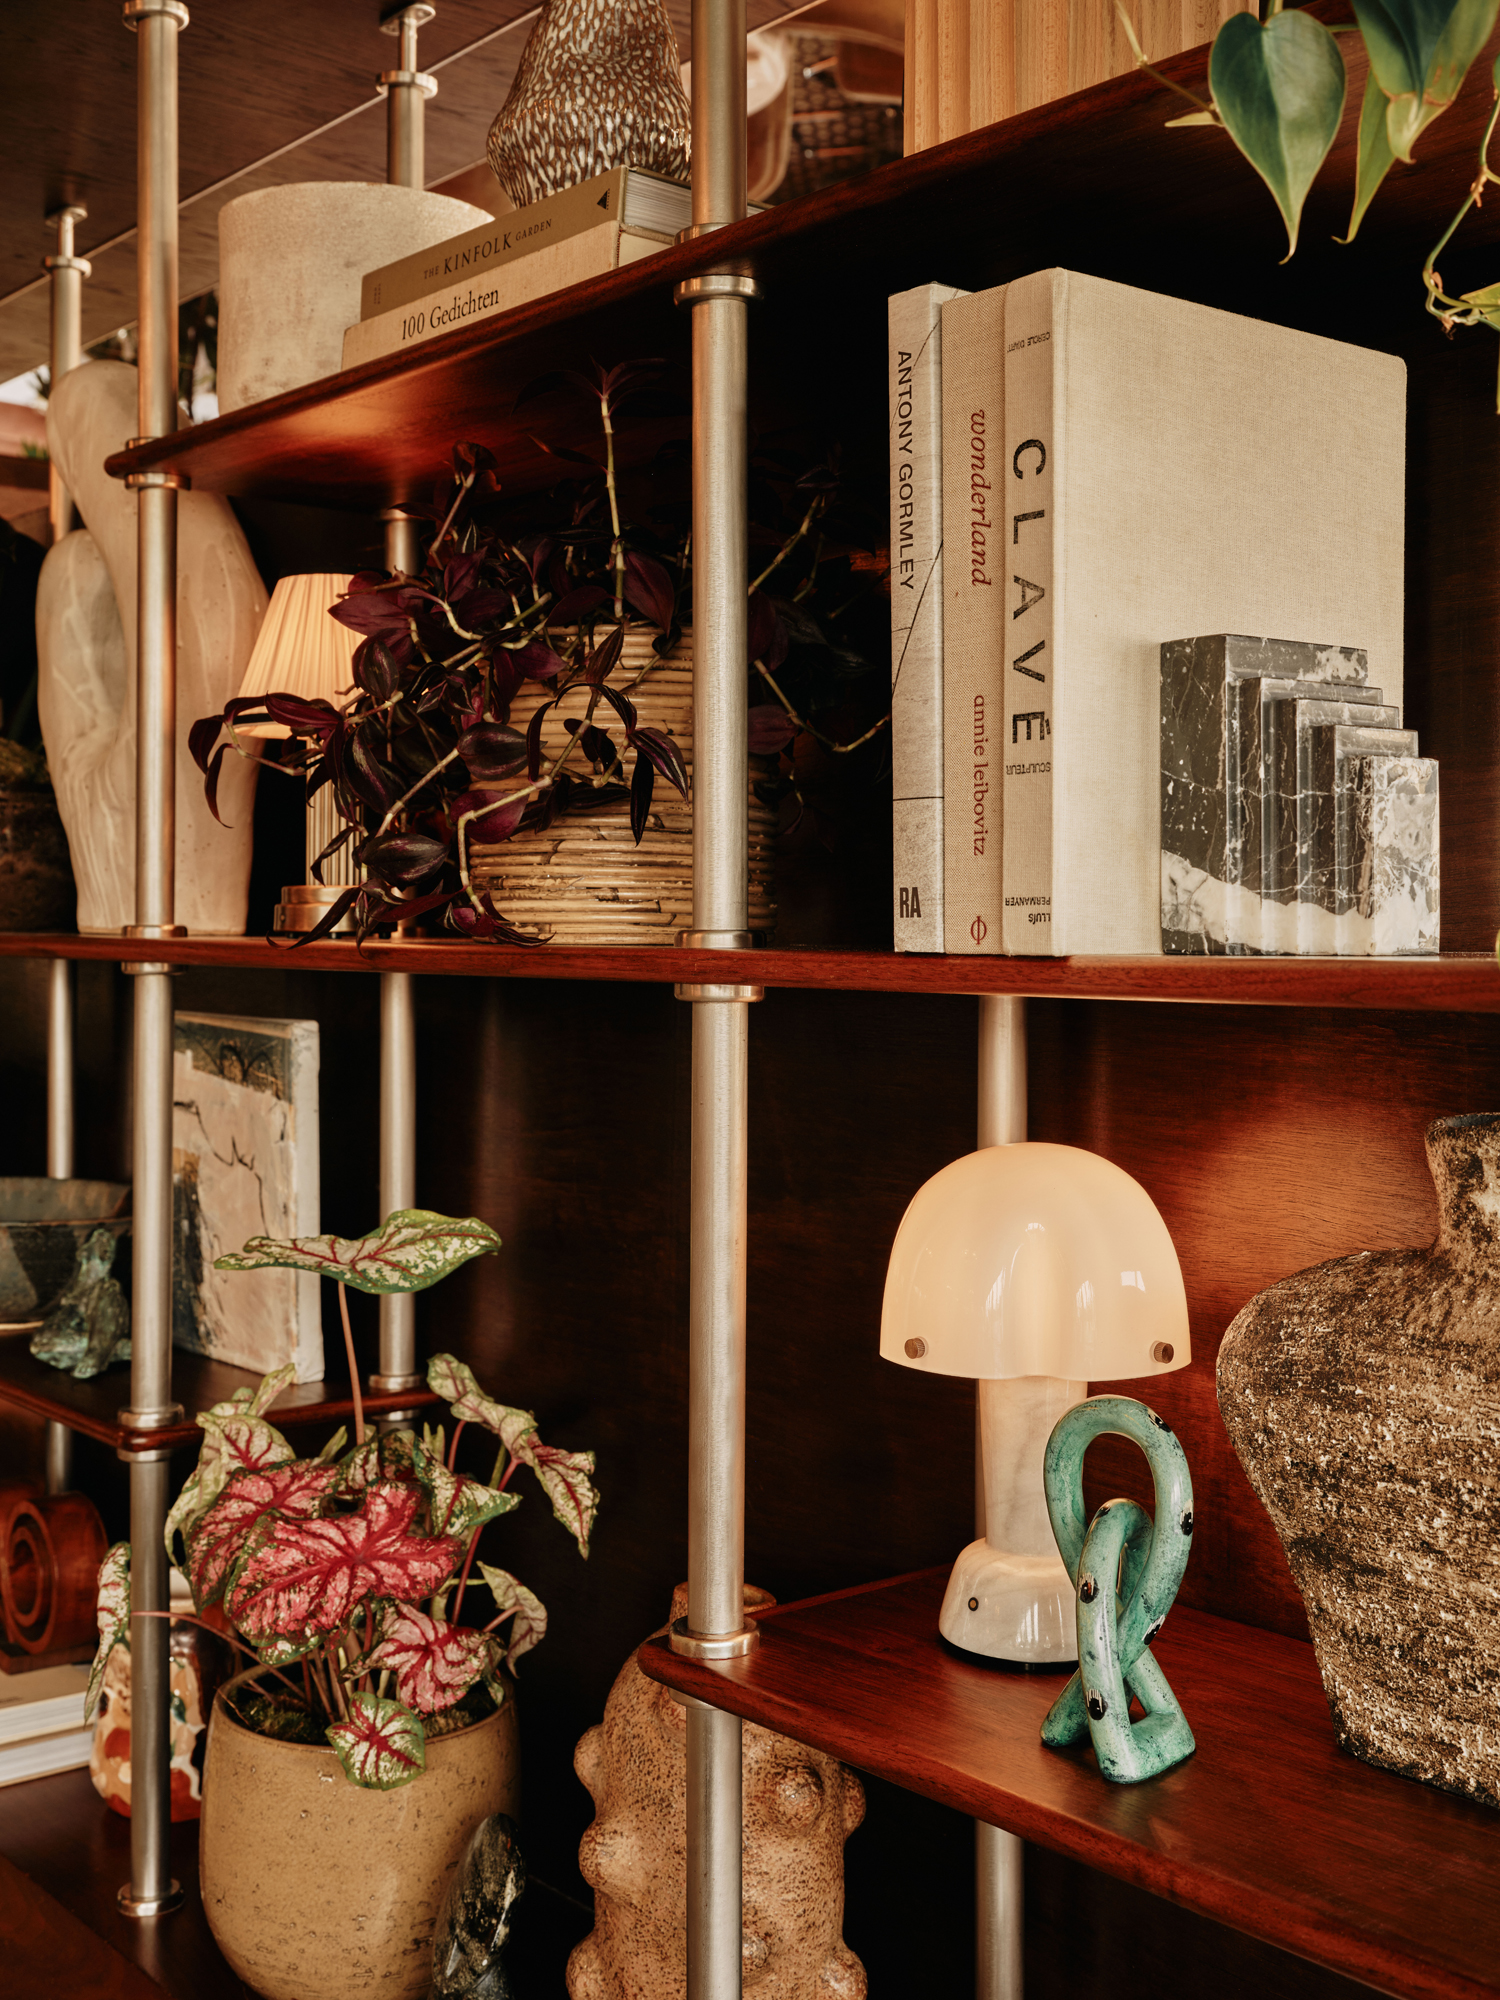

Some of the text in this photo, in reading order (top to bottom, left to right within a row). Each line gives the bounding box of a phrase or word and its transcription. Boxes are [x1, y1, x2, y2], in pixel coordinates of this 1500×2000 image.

[424, 219, 552, 280] THE KINFOLK GARDEN
[402, 289, 500, 341] 100 Gedichten
[897, 350, 915, 591] ANTONY GORMLEY
[970, 408, 992, 587] wonderland
[1012, 437, 1051, 744] CLAVÉ
[973, 694, 989, 856] annie leibovitz
[1005, 761, 1051, 775] SCULPTEUR
[899, 886, 922, 919] RA
[1005, 896, 1051, 907] PERMANYER
